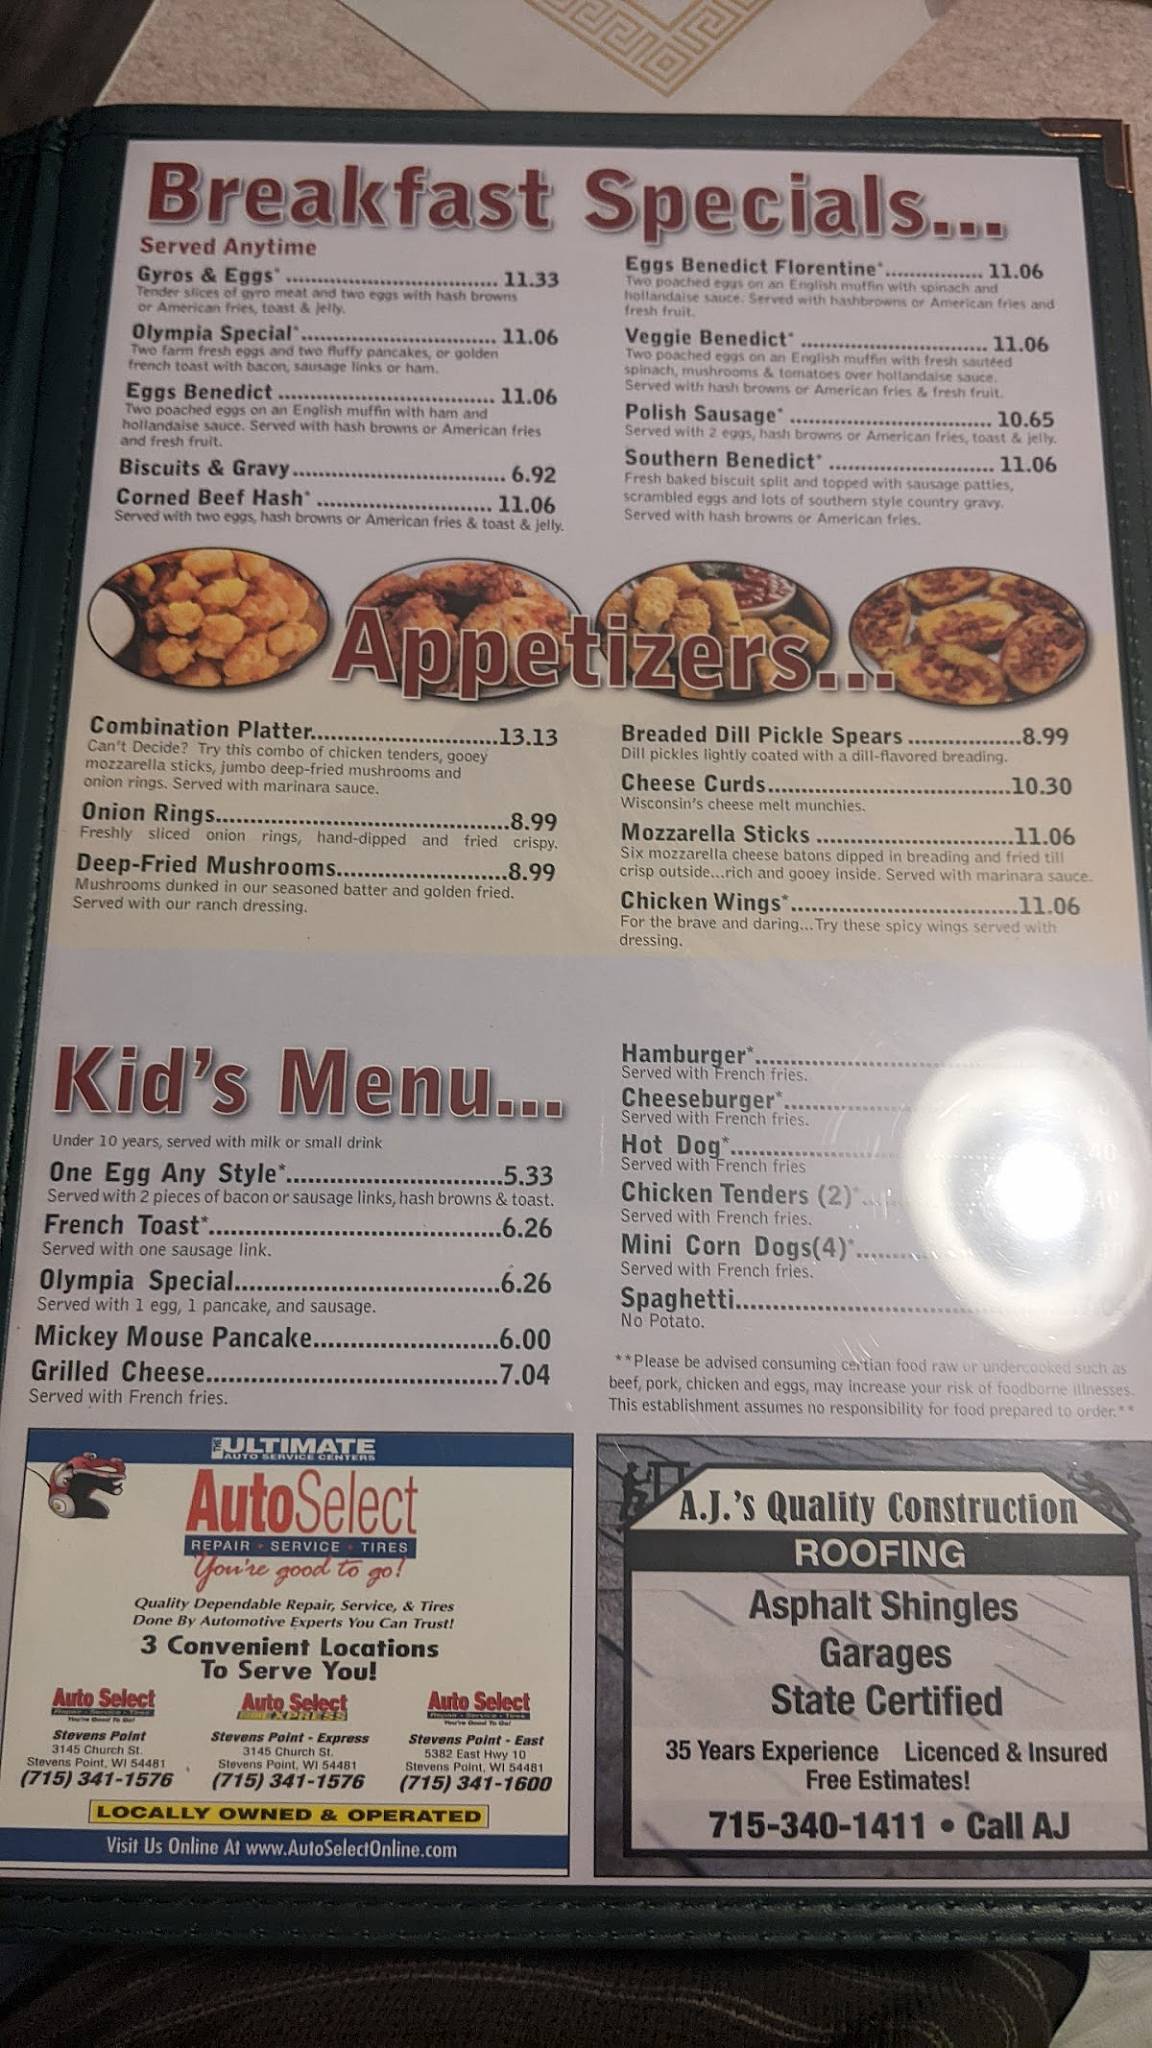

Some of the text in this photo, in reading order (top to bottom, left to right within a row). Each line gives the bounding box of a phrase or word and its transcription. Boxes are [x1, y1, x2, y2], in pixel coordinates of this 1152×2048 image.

[147, 162, 554, 228] Breakfast
[139, 235, 317, 258] Served Anytime
[131, 323, 213, 344] Olympia
[502, 327, 559, 346] 11.06
[624, 327, 692, 348] Veggie
[993, 335, 1050, 353] 11.06
[125, 381, 558, 405] Eggs Benedict 11.06
[122, 402, 488, 420] Two poached eggs on an English muffin with ham and
[624, 402, 686, 421] Polish
[997, 410, 1055, 428] 10.65
[118, 457, 200, 476] Biscuits
[207, 458, 224, 476] &
[511, 465, 556, 484] 6.92
[622, 490, 1004, 511] scrambled eggs and lots of southern style country gravy.
[89, 715, 229, 737] Combination
[499, 727, 558, 747] 13.13
[621, 723, 1069, 748] Breaded Dill Pickle Spears 8.99
[1011, 776, 1073, 796] 10.30
[81, 801, 145, 821] Onion
[510, 812, 557, 831] 8.99
[619, 796, 866, 812] Wisconsin's cheese melt munchies.
[621, 822, 1076, 846] Mozzarella Sticks 11.06
[75, 852, 198, 875] Deep-Fried
[507, 861, 556, 882] 8.99
[71, 895, 308, 915] Served with our ranch dressing.
[53, 1046, 251, 1118] Kid's
[52, 1133, 383, 1150] Under 10 years, served with milk or small drink
[39, 1268, 134, 1294] Olympia
[500, 1271, 552, 1294] 6.26
[620, 1311, 705, 1329] No Potato.
[34, 1323, 118, 1351] Mickey
[126, 1324, 204, 1348] Mouse
[499, 1327, 551, 1350] 6.00
[31, 1358, 109, 1382] Grilled
[499, 1362, 550, 1386] 7.04
[27, 1387, 228, 1408] Served with French fries.
[222, 1437, 376, 1454] ULTIMATE
[184, 1469, 419, 1534] AutoSelect
[676, 1486, 1082, 1526] A.J.'s Quality Construction
[190, 1539, 408, 1553] REPAIR SERVICE TIRES
[794, 1538, 966, 1568] ROOFING
[193, 1552, 270, 1593] You're
[274, 1556, 331, 1588] good
[338, 1559, 363, 1578] to
[748, 1589, 1019, 1628] Asphalt Shingles
[140, 1634, 439, 1658] 3 Convenient Locations
[819, 1636, 952, 1675] Garages
[200, 1659, 377, 1681] To Serve You!
[770, 1683, 1003, 1716] State Certified
[51, 1729, 147, 1742] Stevens Point
[51, 1743, 143, 1756] 3145 Church St.
[665, 1738, 1108, 1765] 35 Years Experience Licenced & Insured
[20, 1769, 175, 1789] (715) 341-1576
[805, 1768, 970, 1791] Free Estimates!
[96, 1805, 482, 1823] LOCALLY OWNED & OPERATED
[708, 1810, 1070, 1840] 715-340-1411 Call AJ
[106, 1835, 457, 1858] Visit Us Online At www.AutoSelectOnline.com
